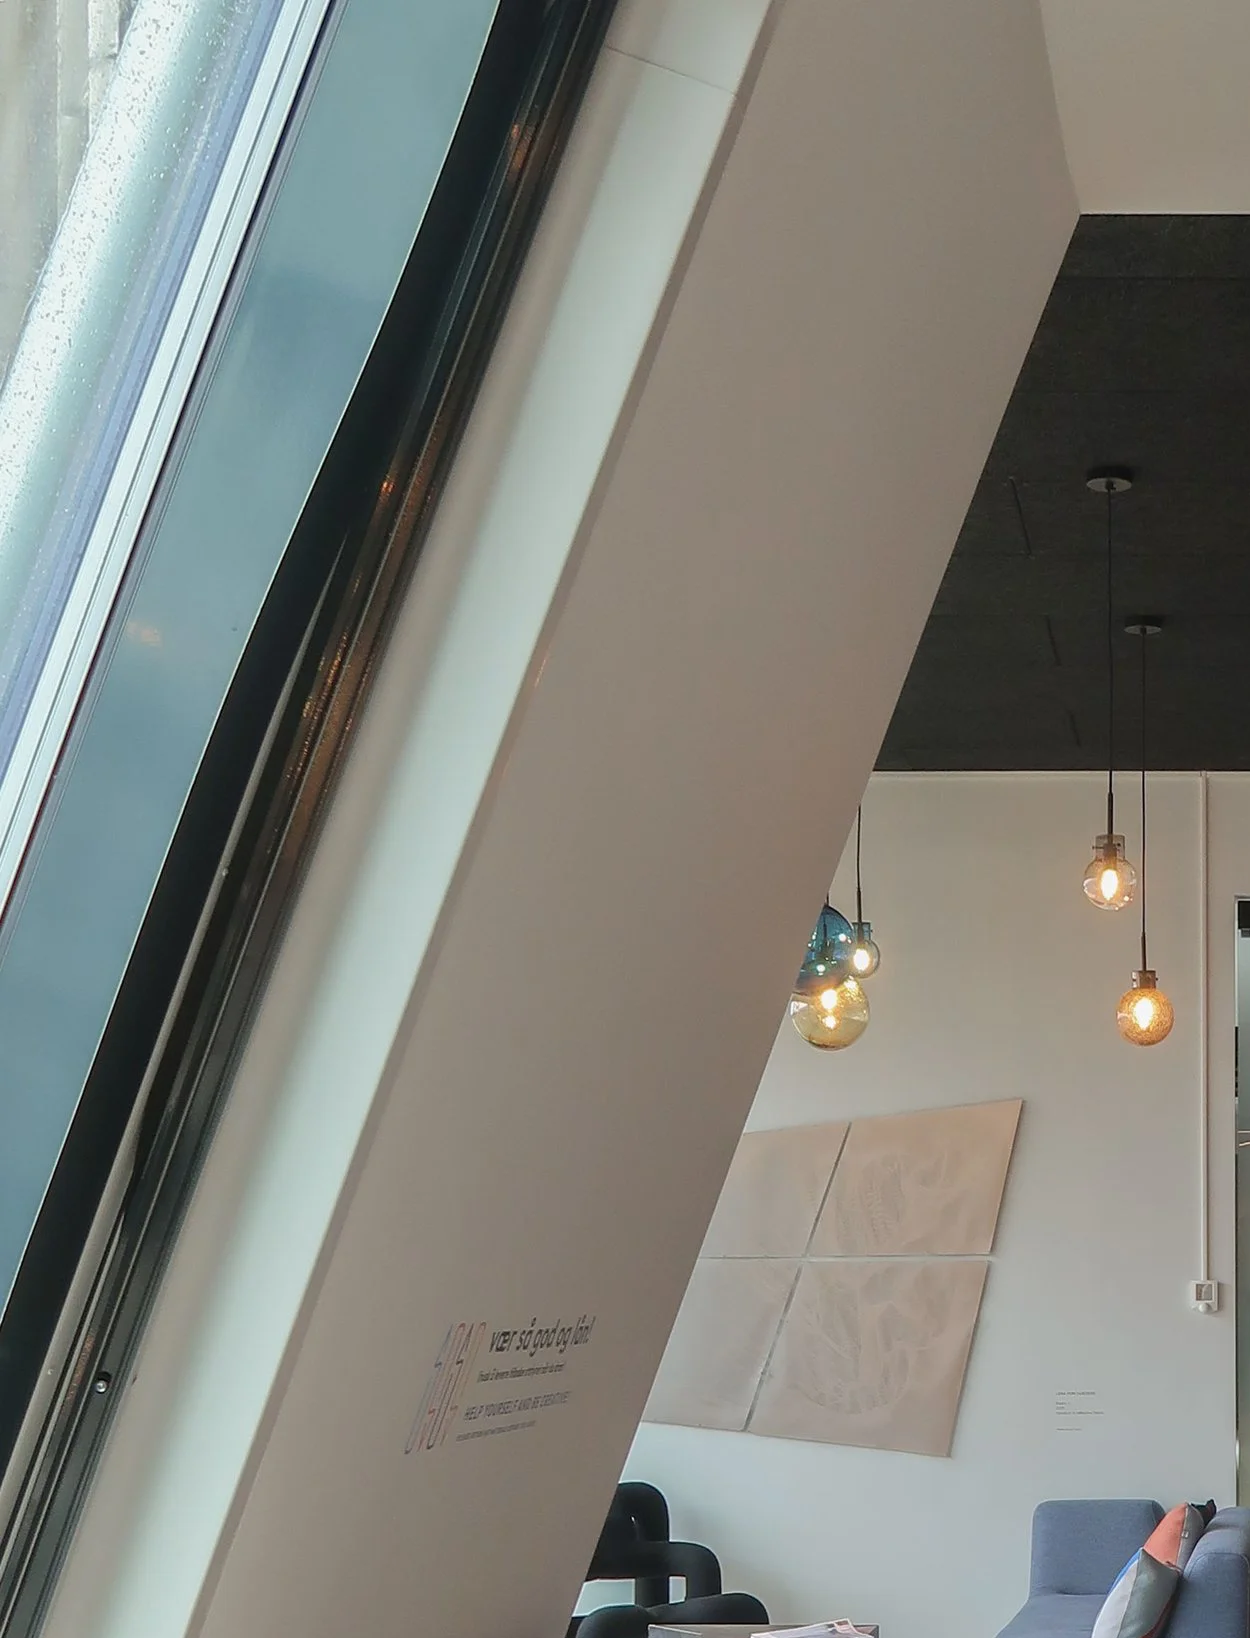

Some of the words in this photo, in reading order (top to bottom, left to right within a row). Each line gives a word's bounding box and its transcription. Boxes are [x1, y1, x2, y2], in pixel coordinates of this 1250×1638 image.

[516, 1316, 537, 1351] så
[529, 1318, 561, 1358] god
[556, 1326, 573, 1354] og
